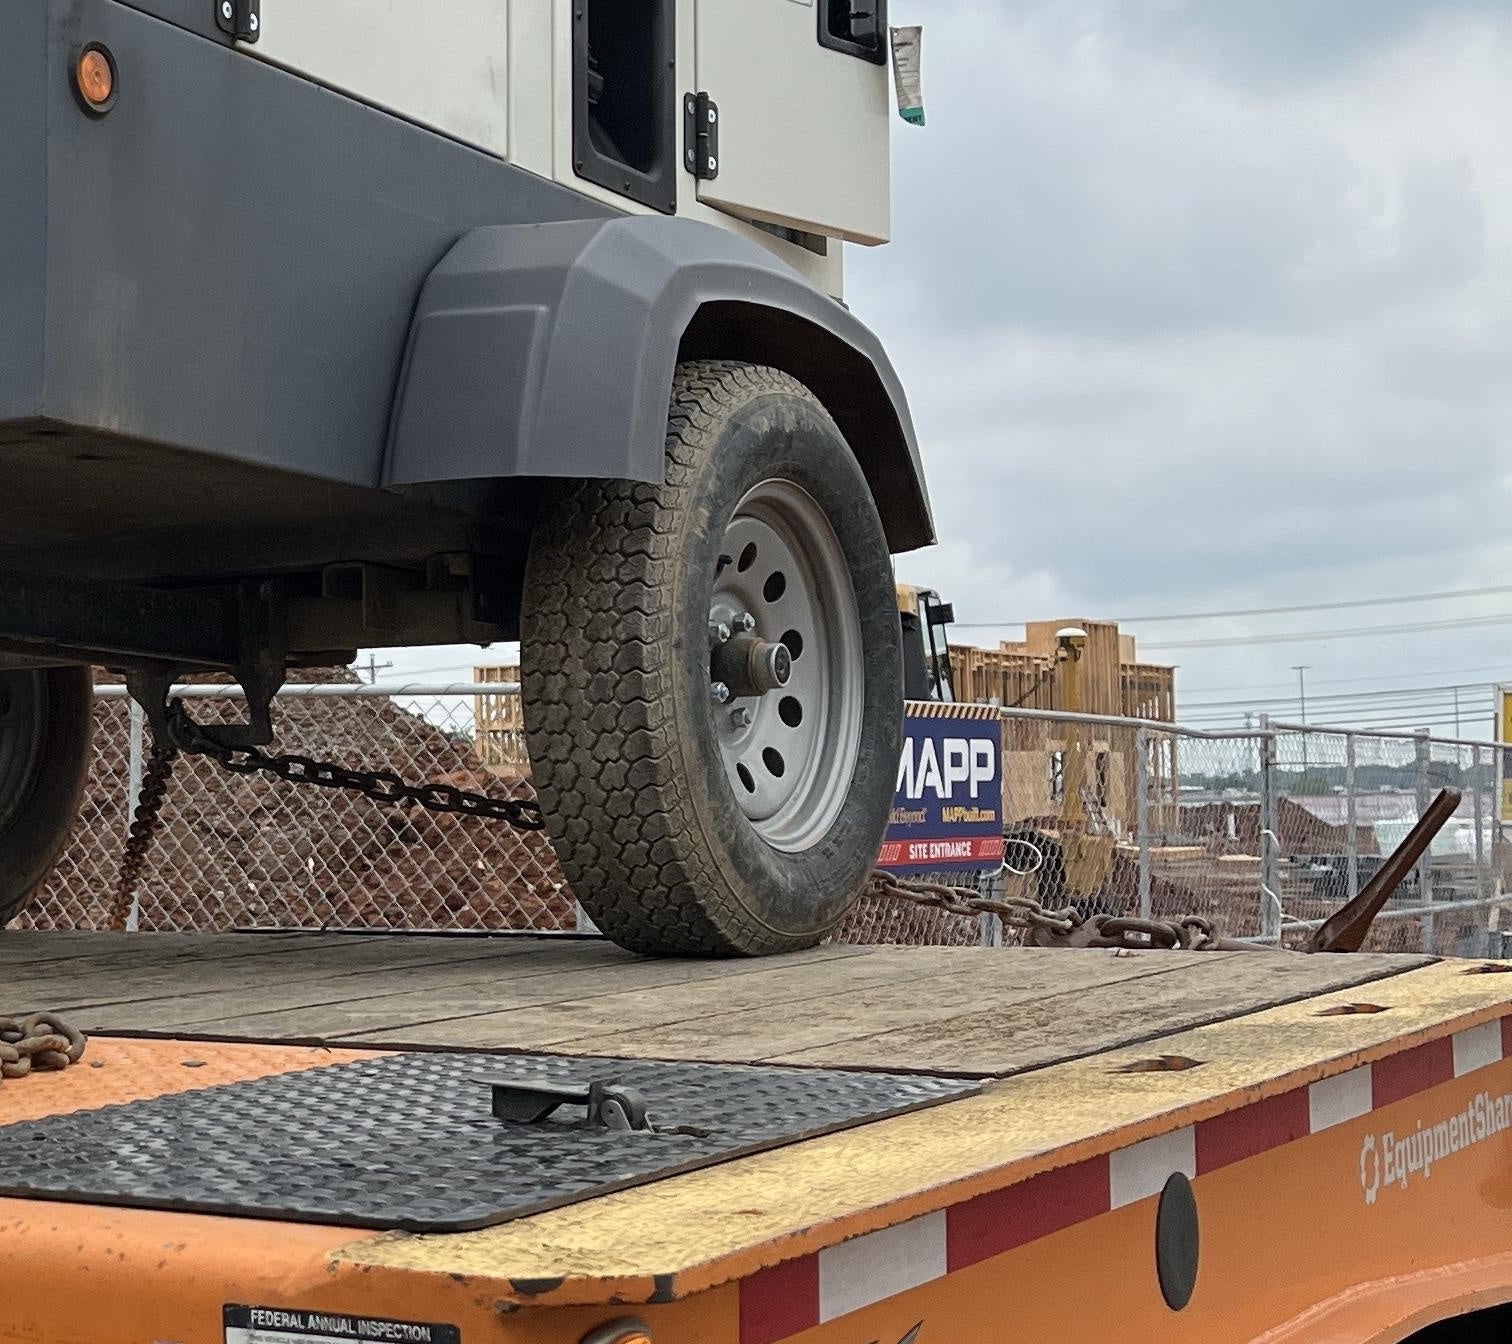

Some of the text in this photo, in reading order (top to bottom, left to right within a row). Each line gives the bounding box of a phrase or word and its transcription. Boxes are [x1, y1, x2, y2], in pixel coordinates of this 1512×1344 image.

[896, 737, 995, 799] MAPP
[909, 842, 972, 859] SITE ENTRANCE
[1382, 1091, 1512, 1189] EquipmentShar
[250, 1309, 431, 1342] FEDERAL ANNUAL INSPECTION
